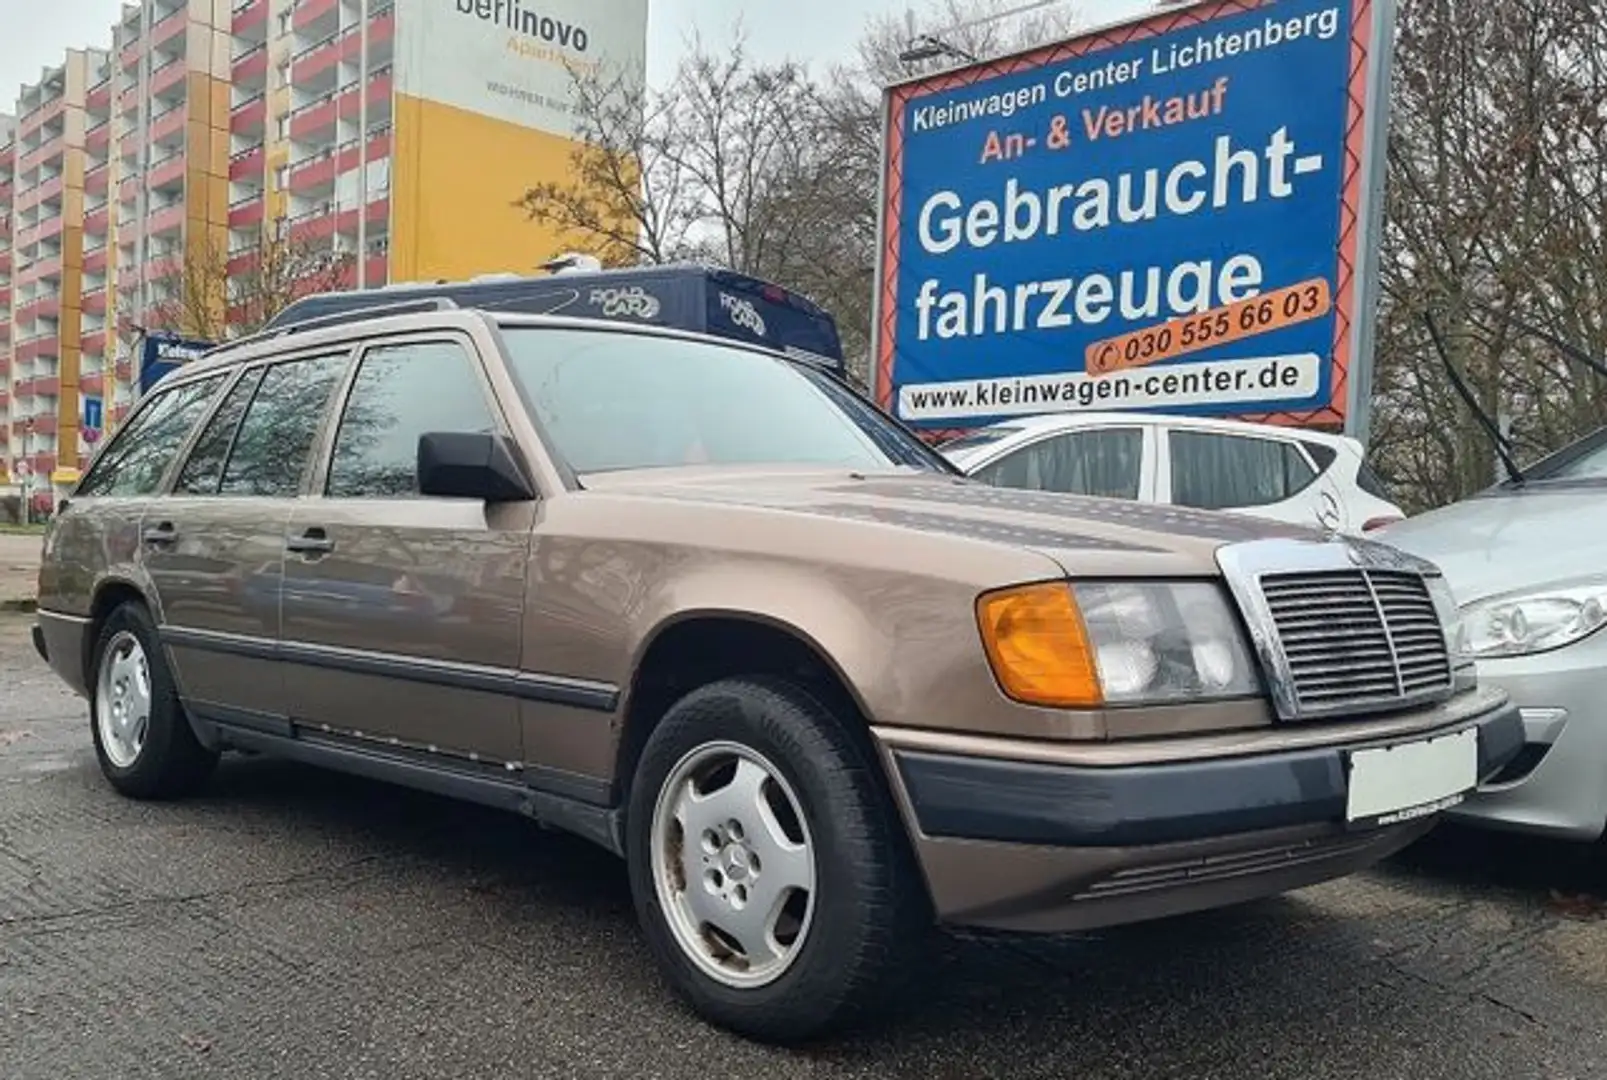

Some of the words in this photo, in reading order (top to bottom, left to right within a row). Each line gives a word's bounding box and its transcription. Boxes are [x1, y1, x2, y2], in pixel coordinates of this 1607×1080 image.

[913, 82, 1046, 132] Kleinwagen
[1054, 57, 1144, 97] Center
[1152, 7, 1339, 75] Lichtenberg
[979, 129, 1037, 164] An-
[1046, 114, 1071, 149] &
[1082, 76, 1229, 142] Verkauf
[918, 126, 1324, 253] Gebraucht-
[915, 253, 1263, 341] fahrzeuge
[1124, 328, 1172, 361] 030
[1180, 312, 1230, 346] 555
[1239, 300, 1273, 330] 66
[1283, 286, 1320, 317] 03
[911, 361, 1299, 409] www.kleinwagen-center.de
